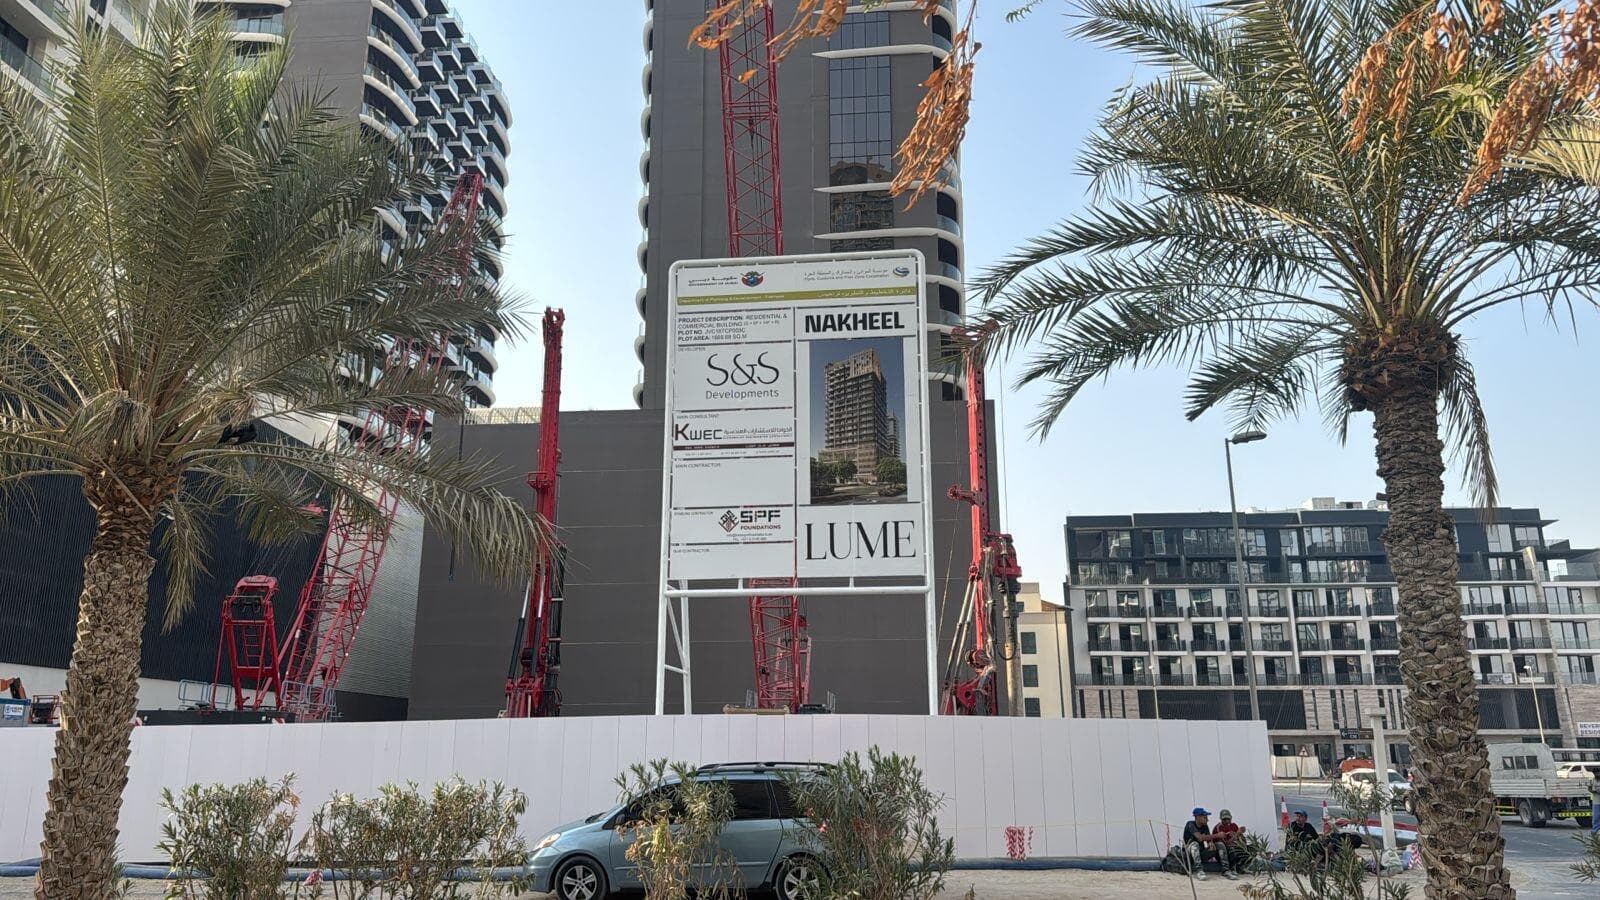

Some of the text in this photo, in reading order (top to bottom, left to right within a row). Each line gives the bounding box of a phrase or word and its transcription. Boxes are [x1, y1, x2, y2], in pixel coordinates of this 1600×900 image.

[804, 310, 905, 333] NAKHEEL
[706, 351, 780, 386] S&S
[705, 388, 780, 400] Developments
[740, 509, 781, 523] SPF
[804, 520, 916, 560] LUME
